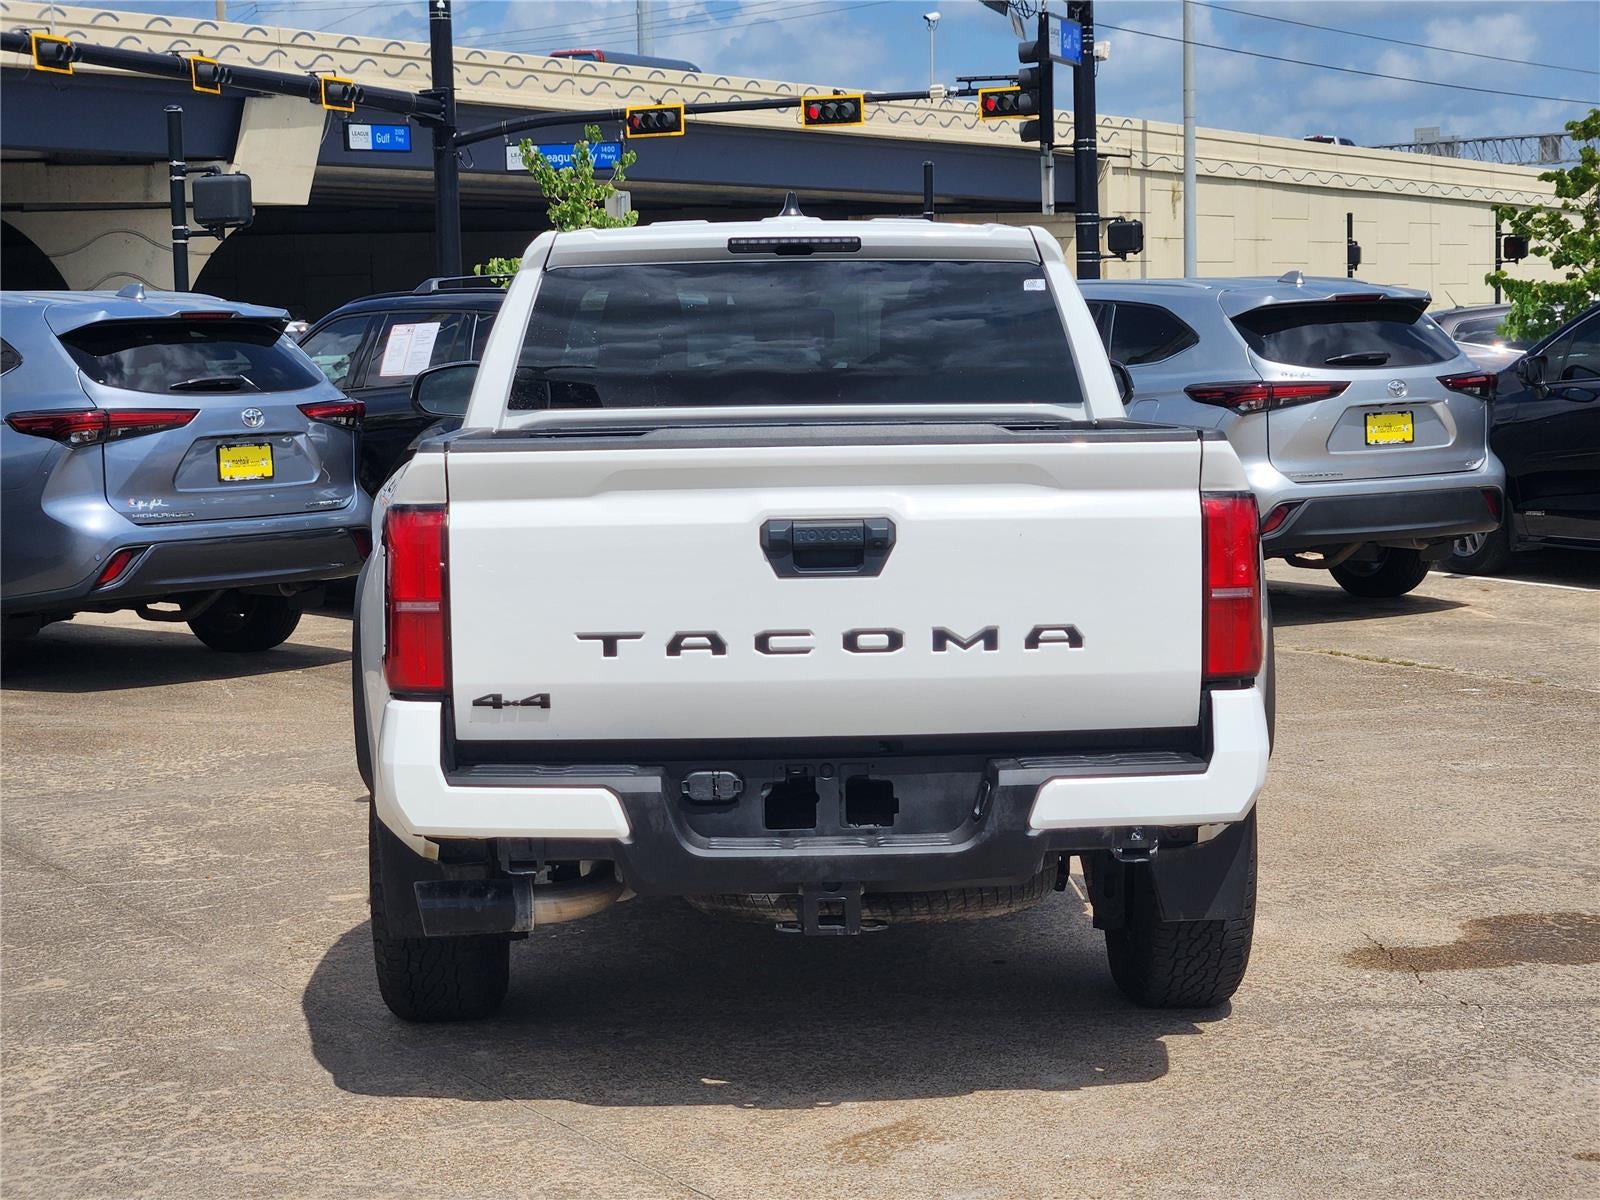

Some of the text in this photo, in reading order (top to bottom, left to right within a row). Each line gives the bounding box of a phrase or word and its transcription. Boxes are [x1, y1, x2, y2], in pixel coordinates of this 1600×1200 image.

[376, 132, 390, 144] Gulf
[600, 153, 617, 161] Pkwy
[796, 528, 862, 542] TOYOTA
[574, 624, 1085, 657] TACOMA
